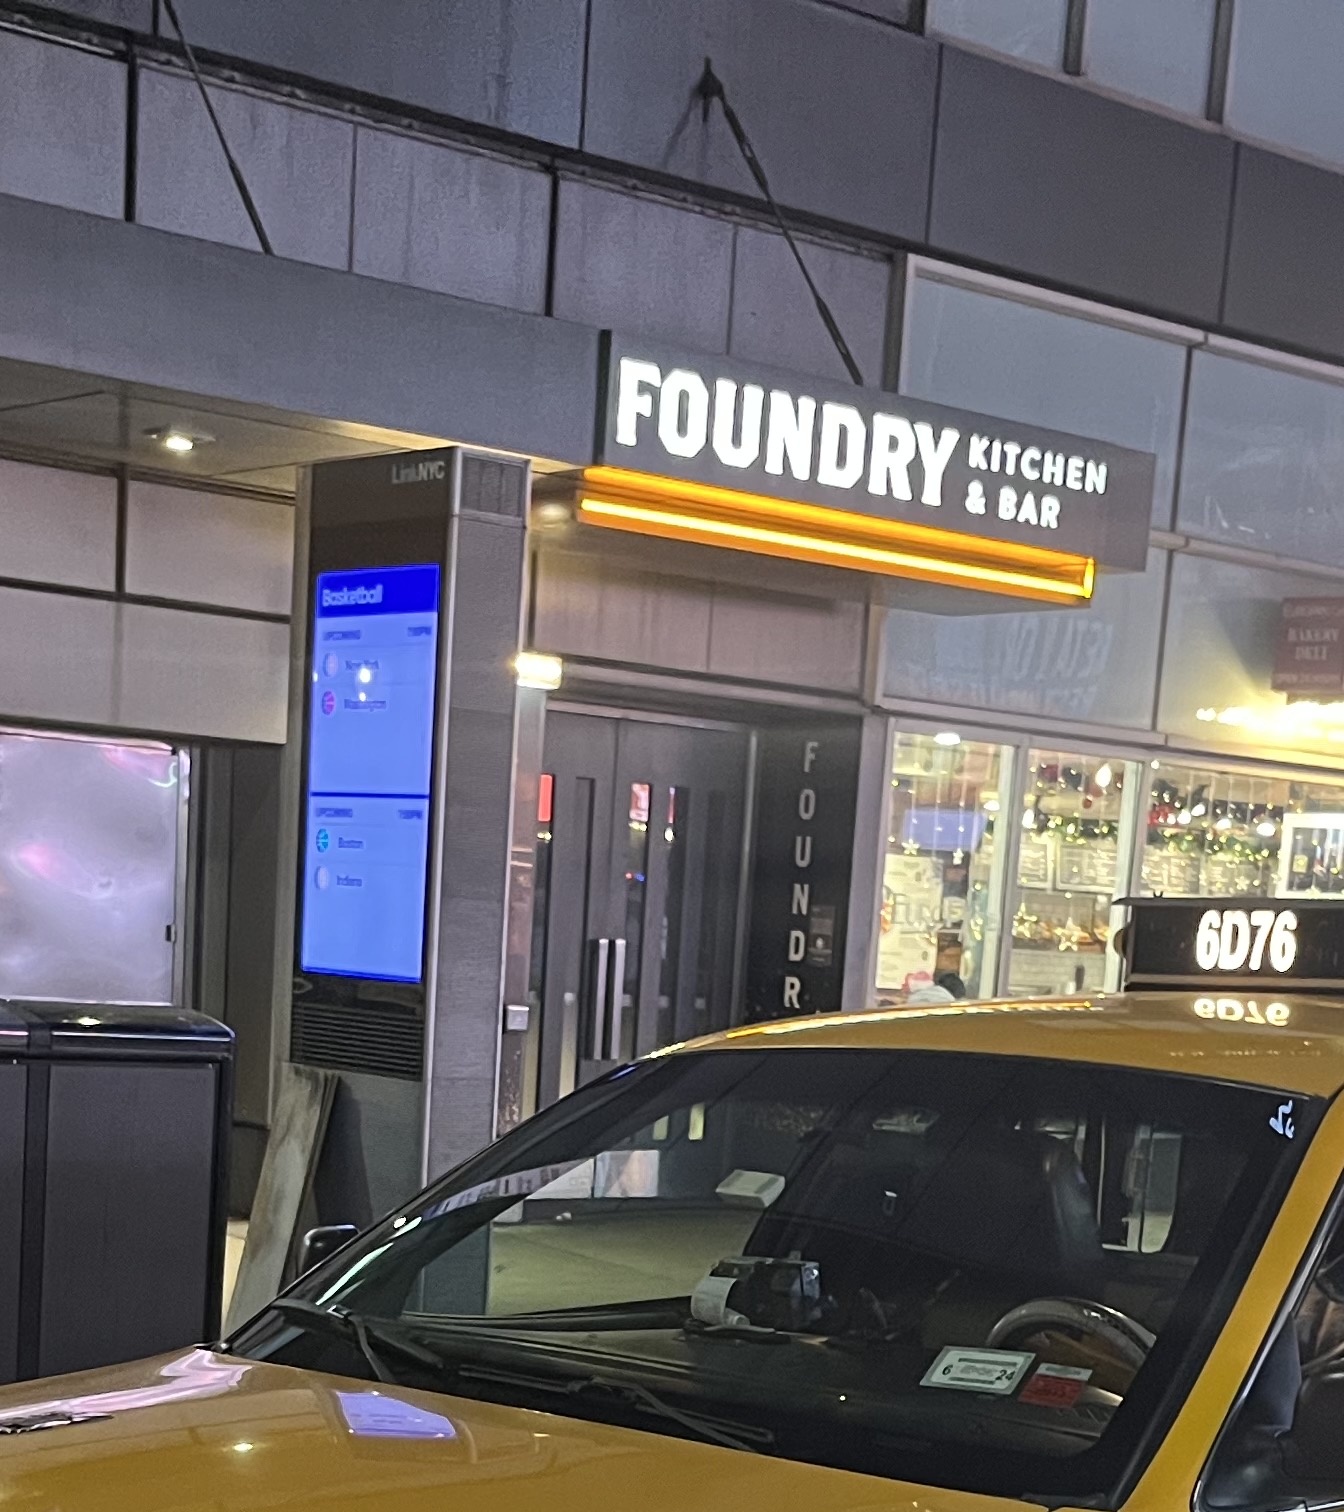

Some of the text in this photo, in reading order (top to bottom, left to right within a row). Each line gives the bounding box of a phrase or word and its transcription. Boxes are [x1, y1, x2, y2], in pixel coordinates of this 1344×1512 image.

[615, 356, 1108, 508] FOUNDRY KITCHEN
[964, 480, 1062, 530] & BAR
[321, 583, 383, 607] Basketball
[783, 740, 819, 1010] FOUNDR
[1196, 909, 1298, 973] 6D76
[941, 1363, 954, 1376] 6
[995, 1368, 1017, 1382] 24
